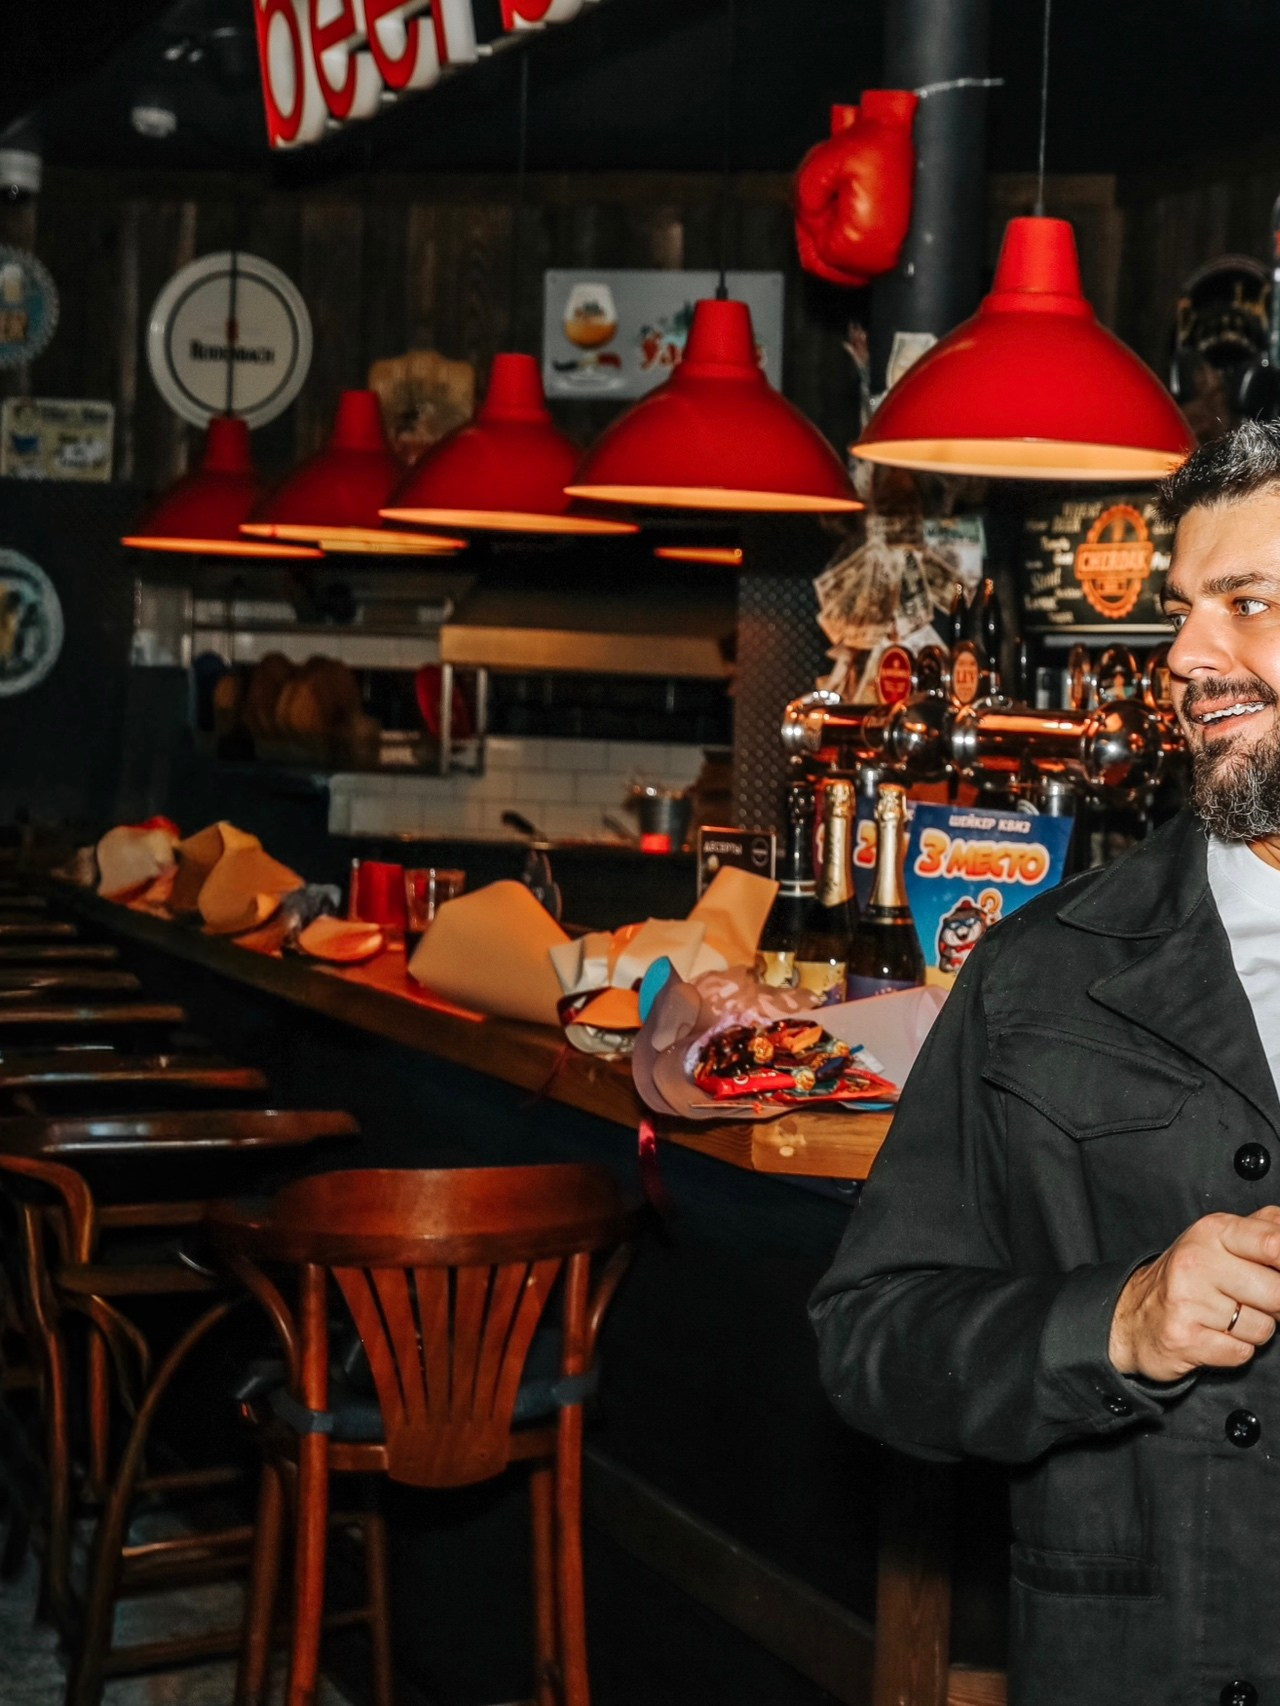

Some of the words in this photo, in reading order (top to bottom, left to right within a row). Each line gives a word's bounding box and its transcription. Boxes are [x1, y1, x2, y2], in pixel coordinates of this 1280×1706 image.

[949, 813, 996, 831] ШЕЙКЕР
[997, 820, 1031, 834] КВИЗ
[914, 828, 949, 878] 3
[945, 841, 1051, 885] МЕСТО
